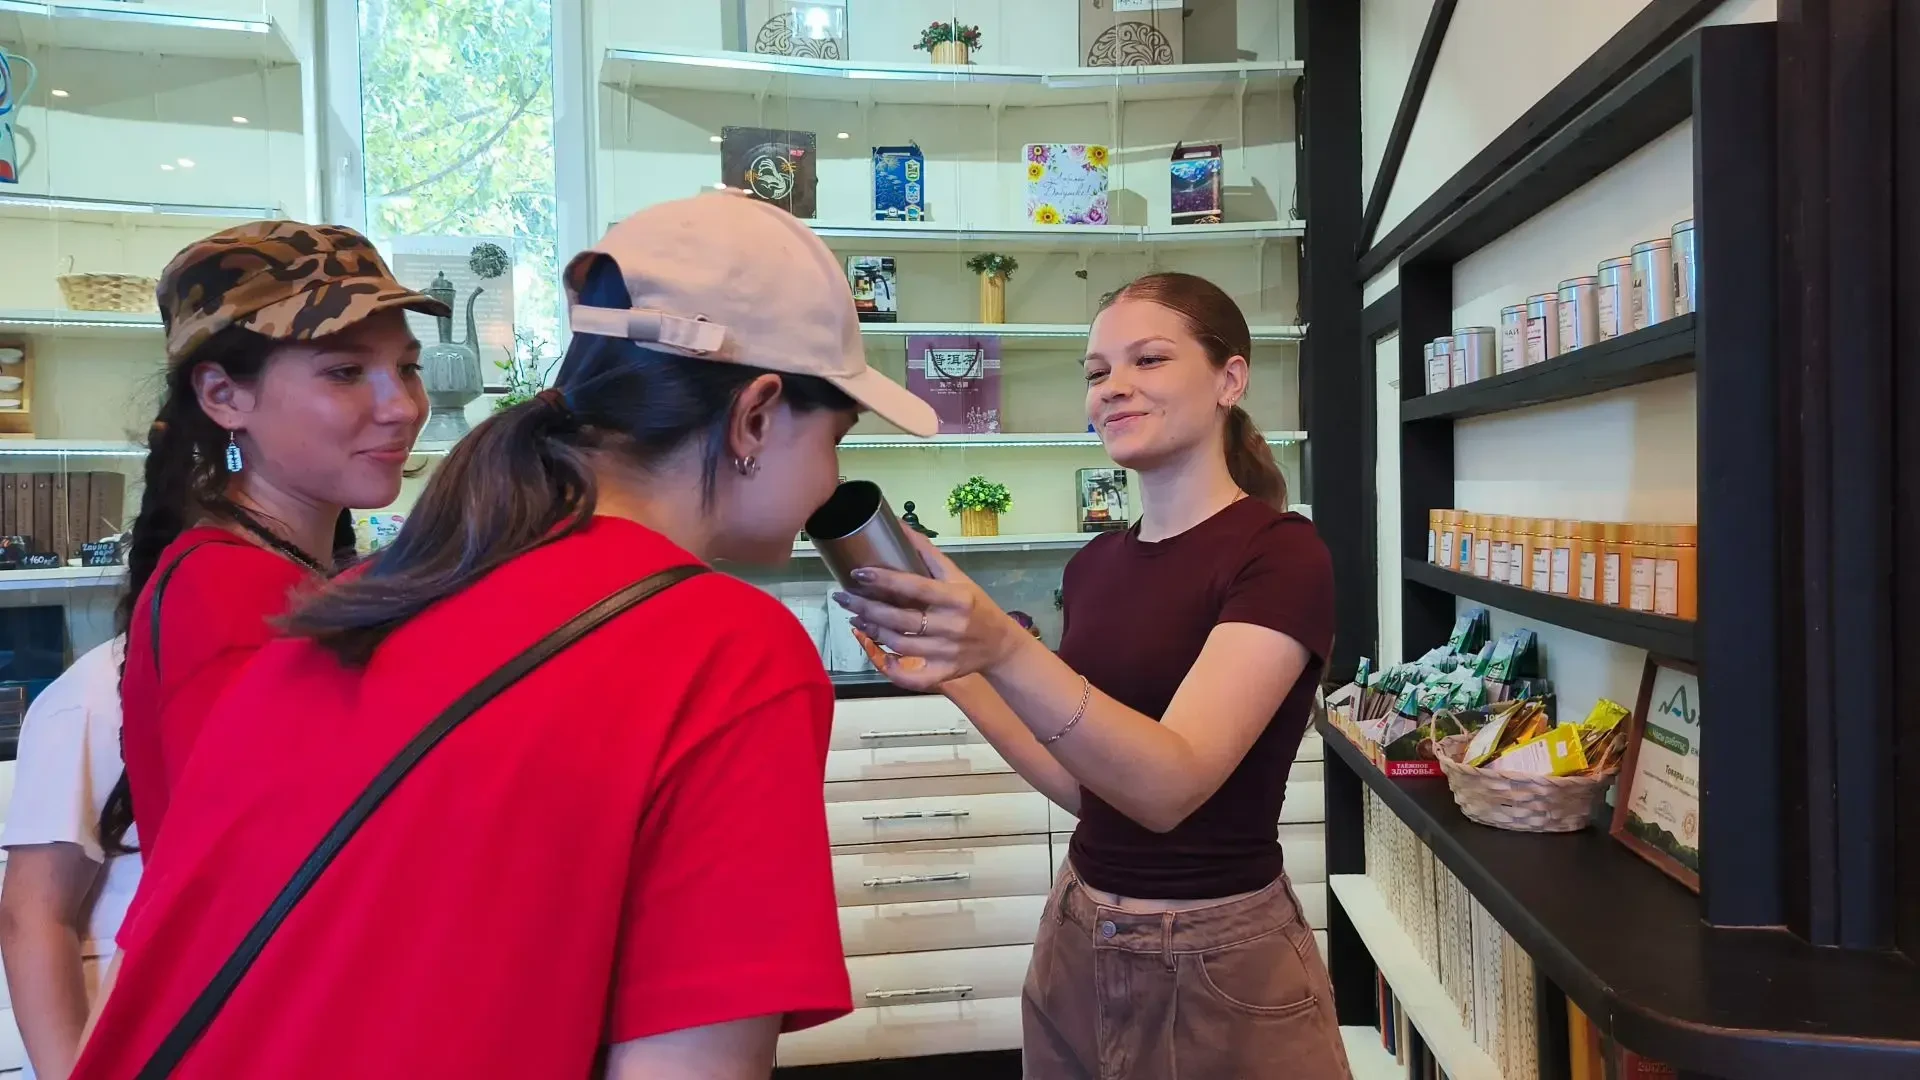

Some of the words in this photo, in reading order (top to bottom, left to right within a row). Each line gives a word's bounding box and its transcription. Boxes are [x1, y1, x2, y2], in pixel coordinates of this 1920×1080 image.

[934, 353, 976, 366] 普洱茶
[1391, 768, 1435, 776] ЗДОРОВЬЕ
[1665, 764, 1685, 781] Товары
